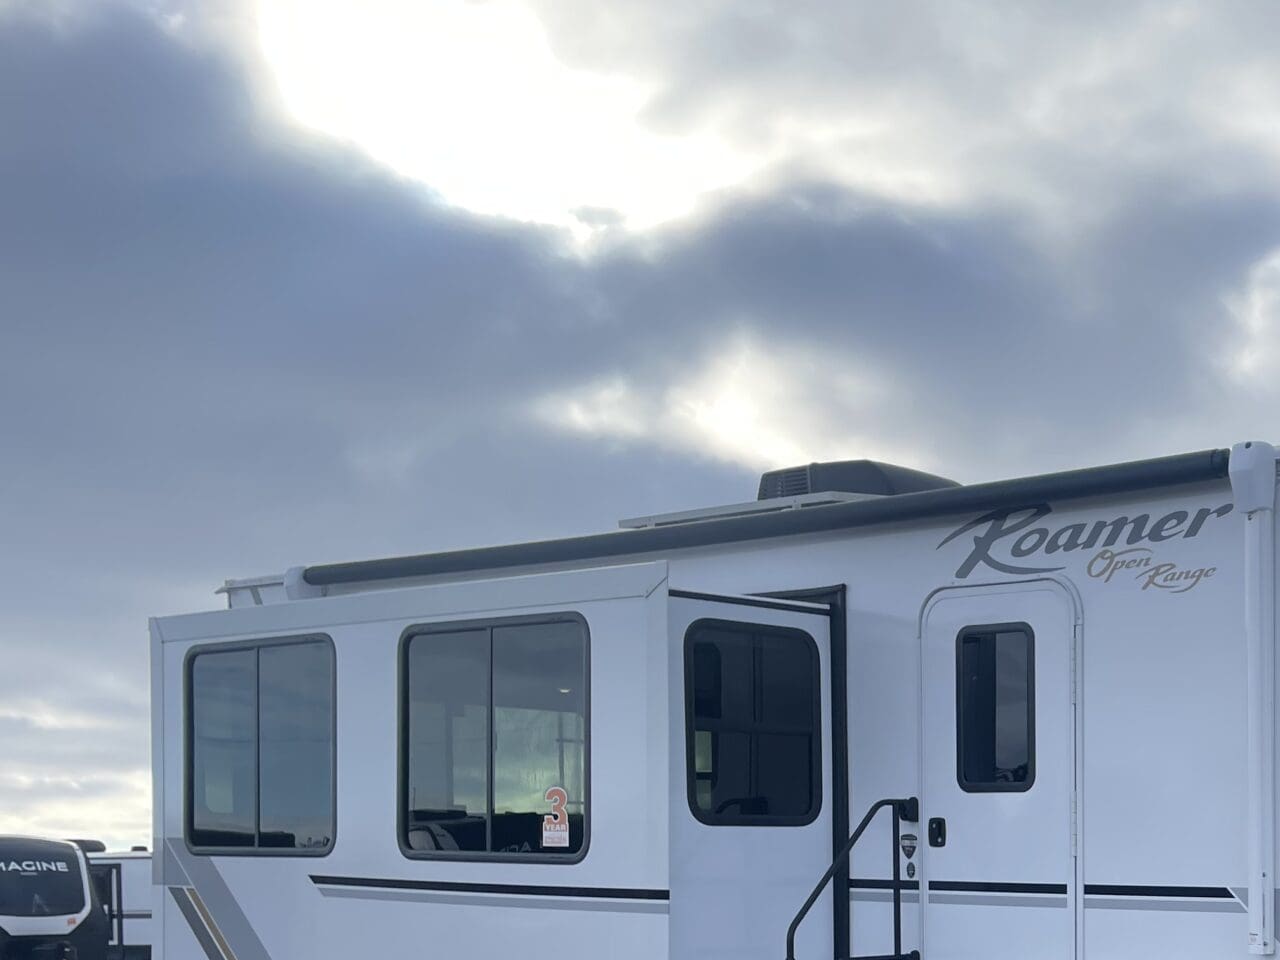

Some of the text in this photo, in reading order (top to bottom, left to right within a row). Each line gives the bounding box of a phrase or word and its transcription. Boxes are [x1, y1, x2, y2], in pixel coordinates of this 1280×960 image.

[936, 502, 1234, 579] Roamer
[1087, 548, 1217, 593] Open Range
[545, 787, 567, 824] 3
